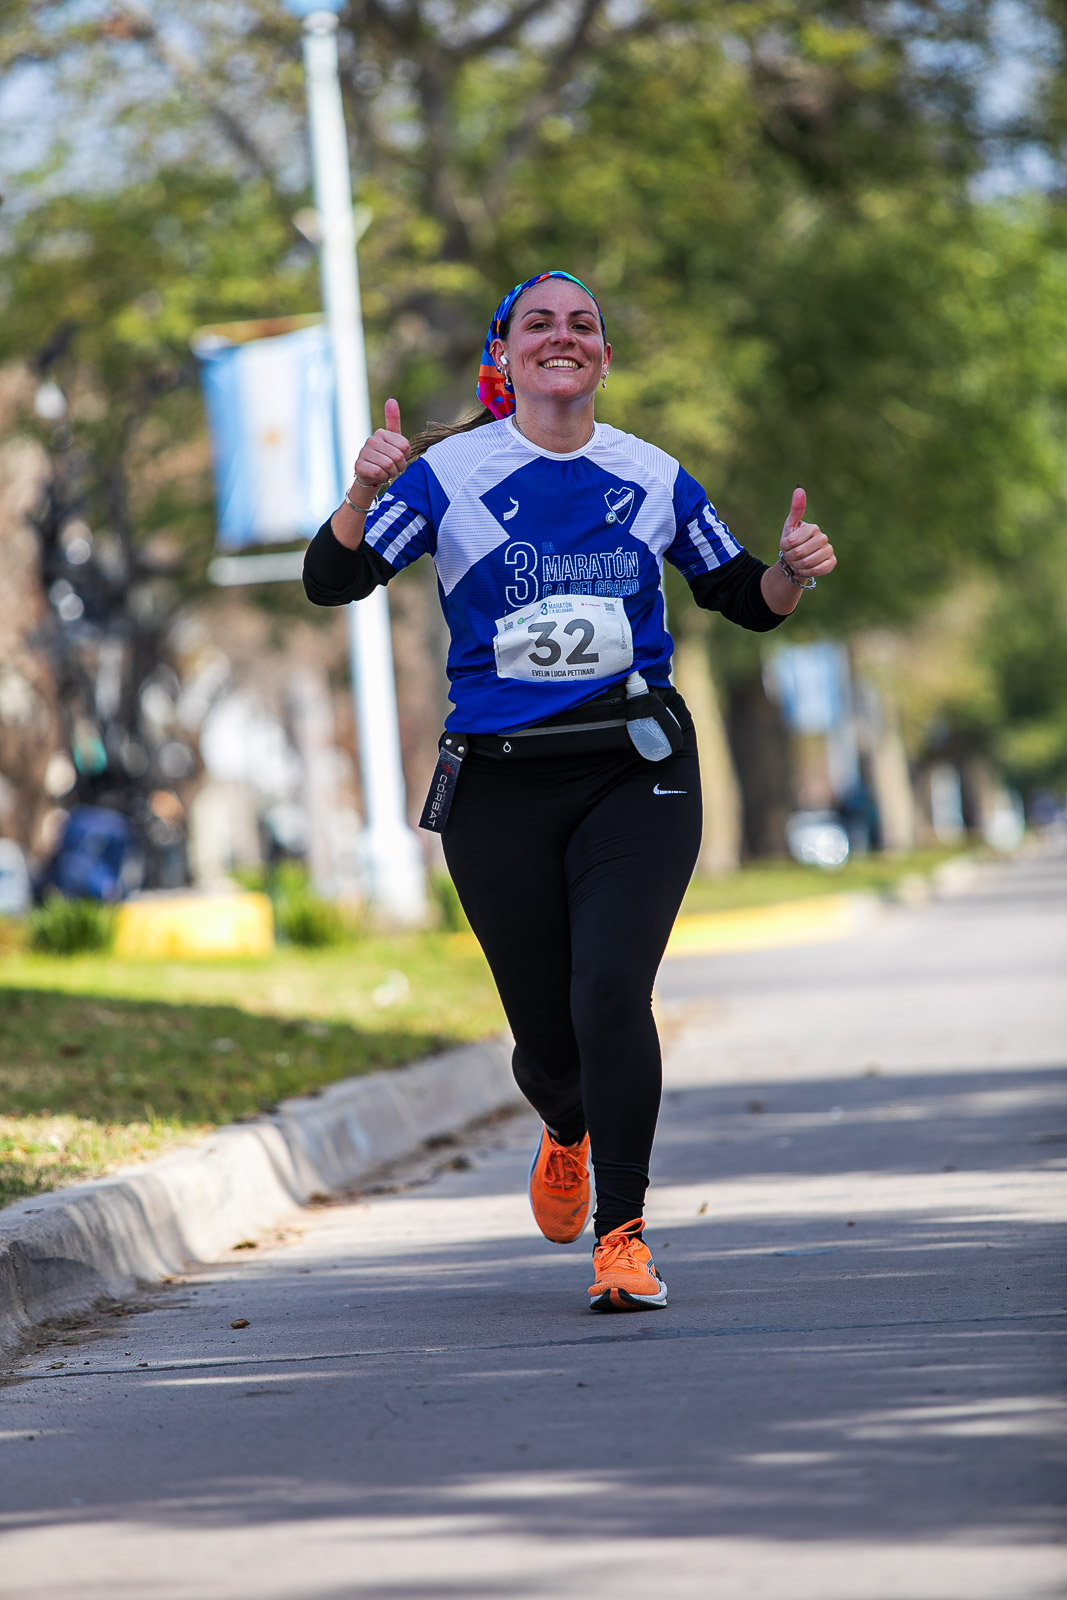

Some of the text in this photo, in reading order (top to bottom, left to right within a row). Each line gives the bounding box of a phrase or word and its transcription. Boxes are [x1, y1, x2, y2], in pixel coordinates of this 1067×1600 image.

[504, 541, 539, 608] 3
[542, 547, 639, 582] MARATÓN
[528, 618, 599, 667] 32
[531, 668, 595, 678] EVELIN LUCIA PETTINARI
[427, 774, 448, 827] CORBAT
